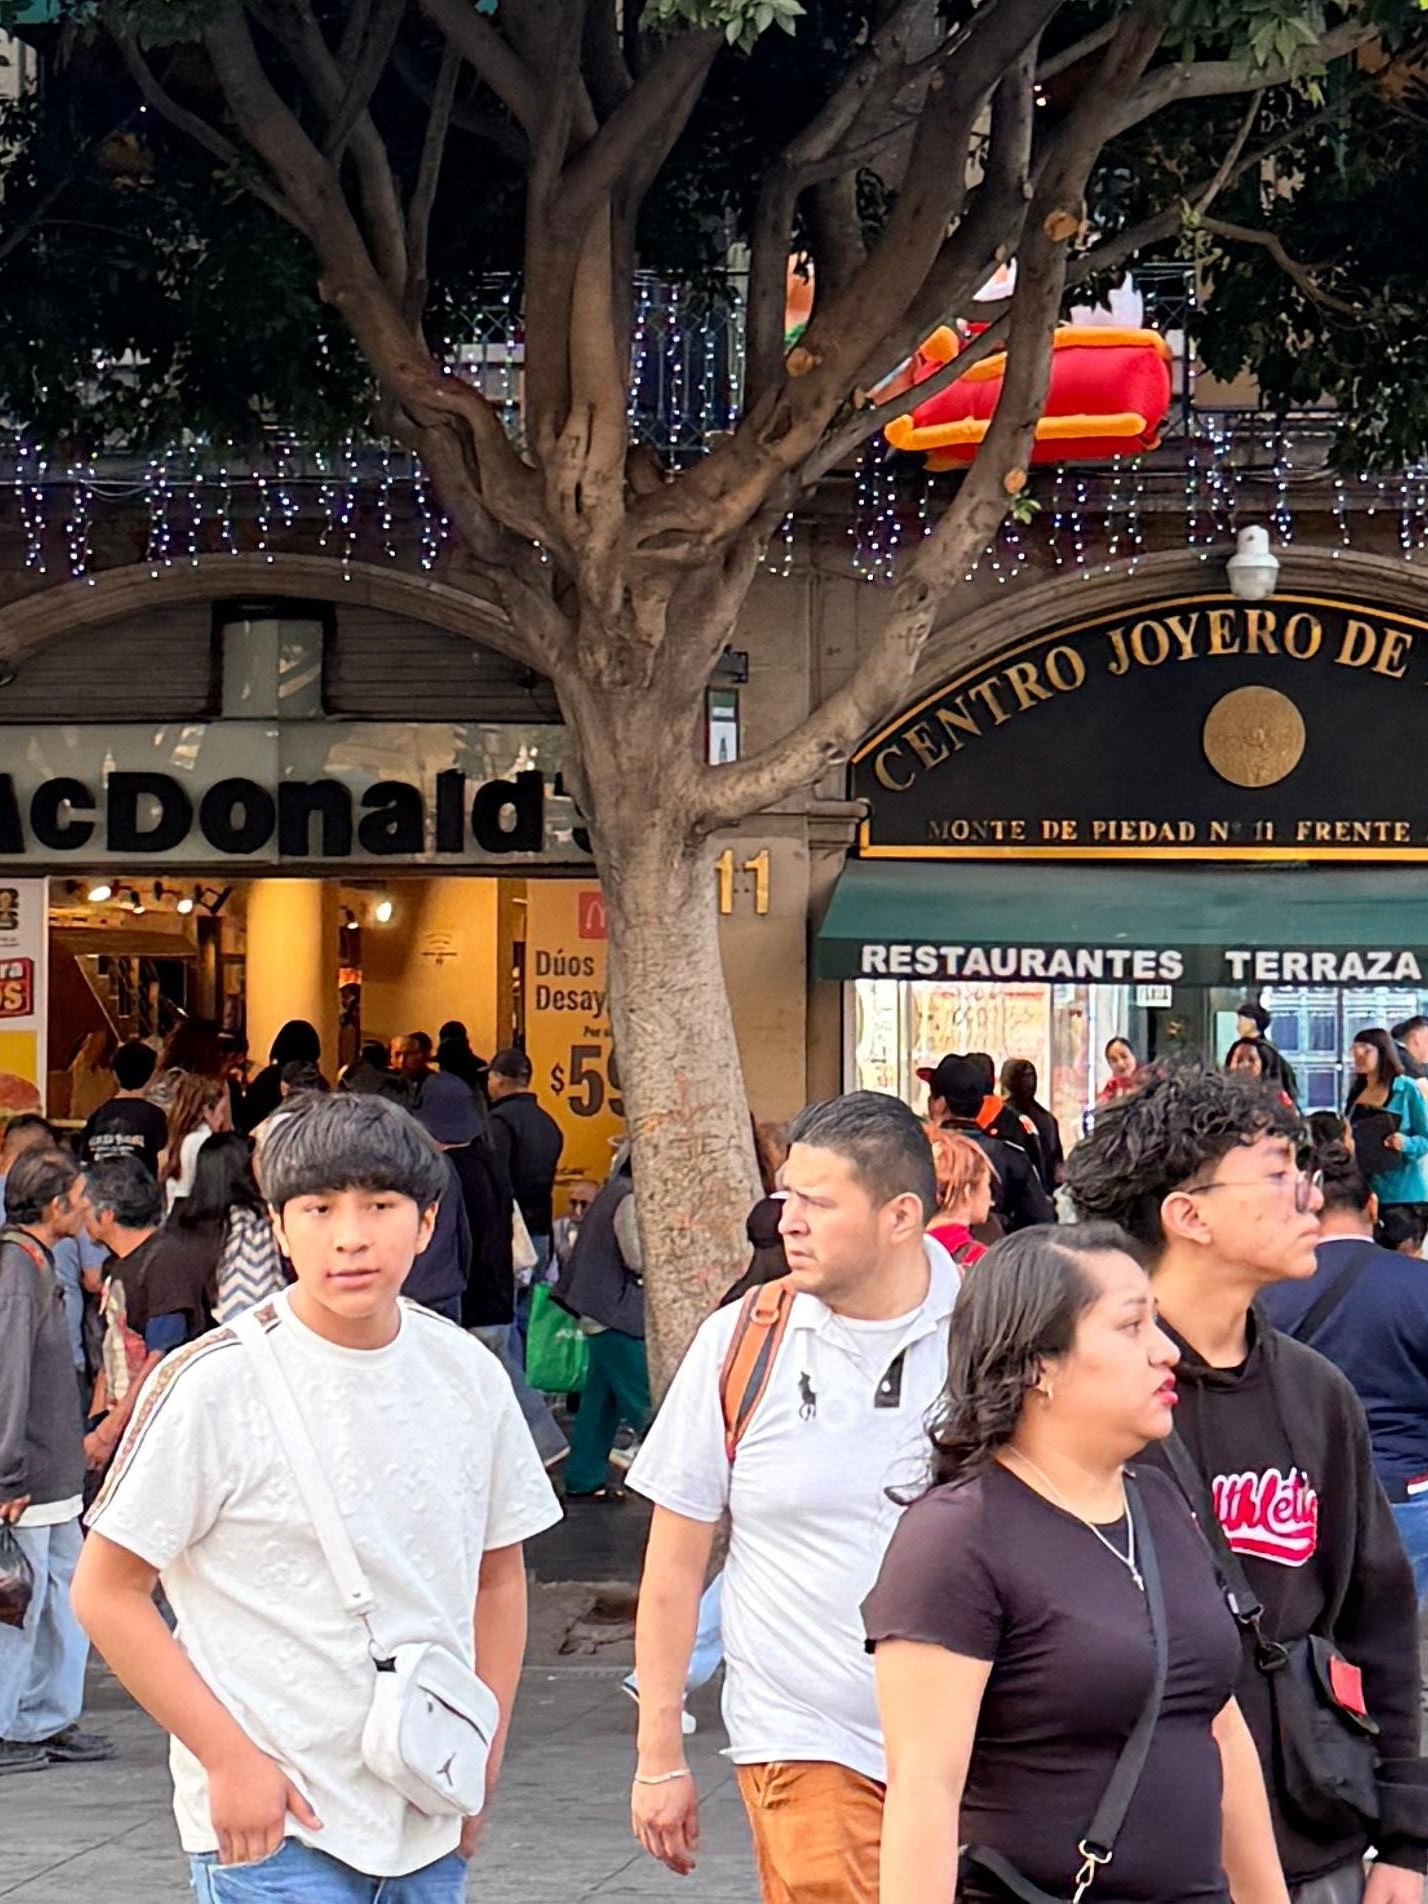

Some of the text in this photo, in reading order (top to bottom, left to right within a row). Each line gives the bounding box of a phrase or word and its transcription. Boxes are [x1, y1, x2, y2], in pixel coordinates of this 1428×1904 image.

[873, 644, 1087, 793] CENTRO
[1107, 608, 1322, 677] JOYERO
[1334, 619, 1413, 679] DE
[929, 819, 1026, 842] MONTE
[1042, 819, 1078, 841] DE
[1092, 820, 1197, 842] PIEDAD
[1295, 820, 1411, 843] FRENTE
[714, 848, 771, 916] 11
[535, 947, 595, 978] Dúos
[861, 944, 1184, 981] RESTAURANTES
[1225, 950, 1423, 982] TERRAZA
[535, 984, 607, 1019] Desay
